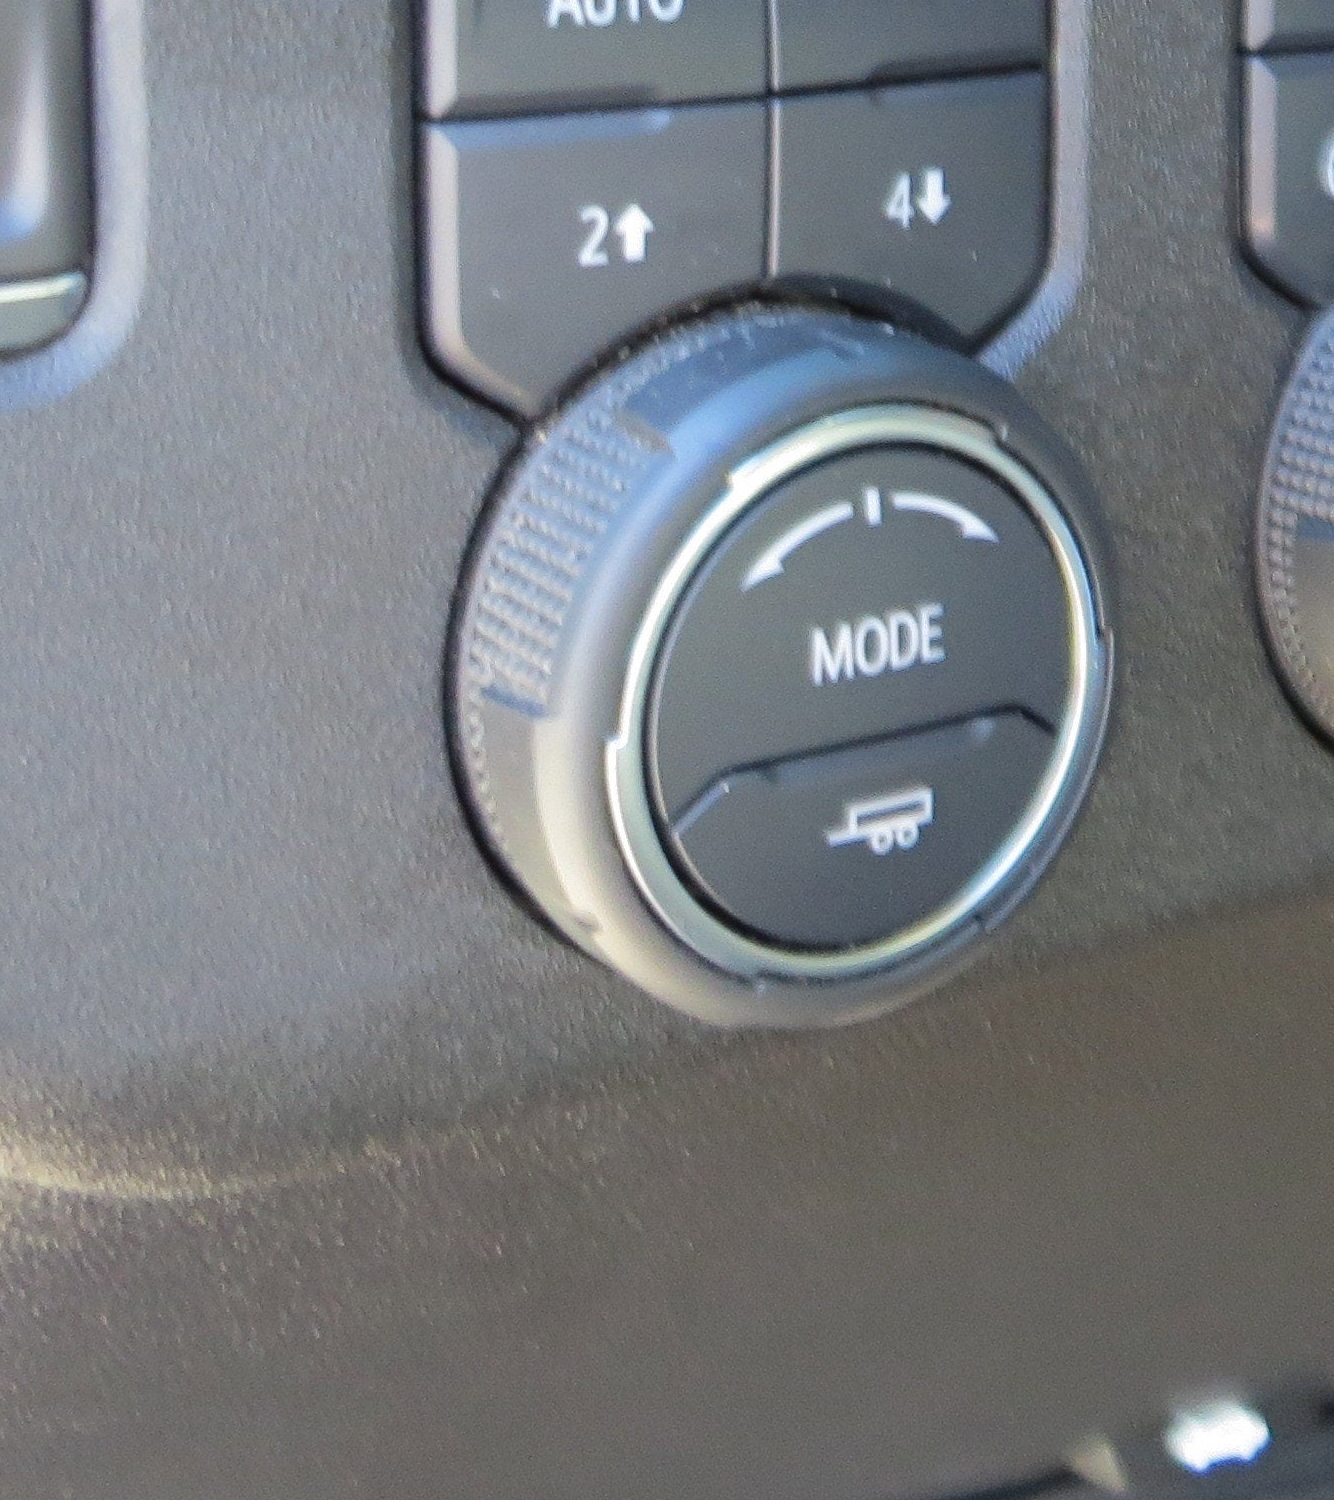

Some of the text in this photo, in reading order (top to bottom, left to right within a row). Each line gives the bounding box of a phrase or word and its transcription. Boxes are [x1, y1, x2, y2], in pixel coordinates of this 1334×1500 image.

[882, 172, 912, 229] 4
[578, 204, 610, 267] 2
[809, 603, 946, 687] MODE
